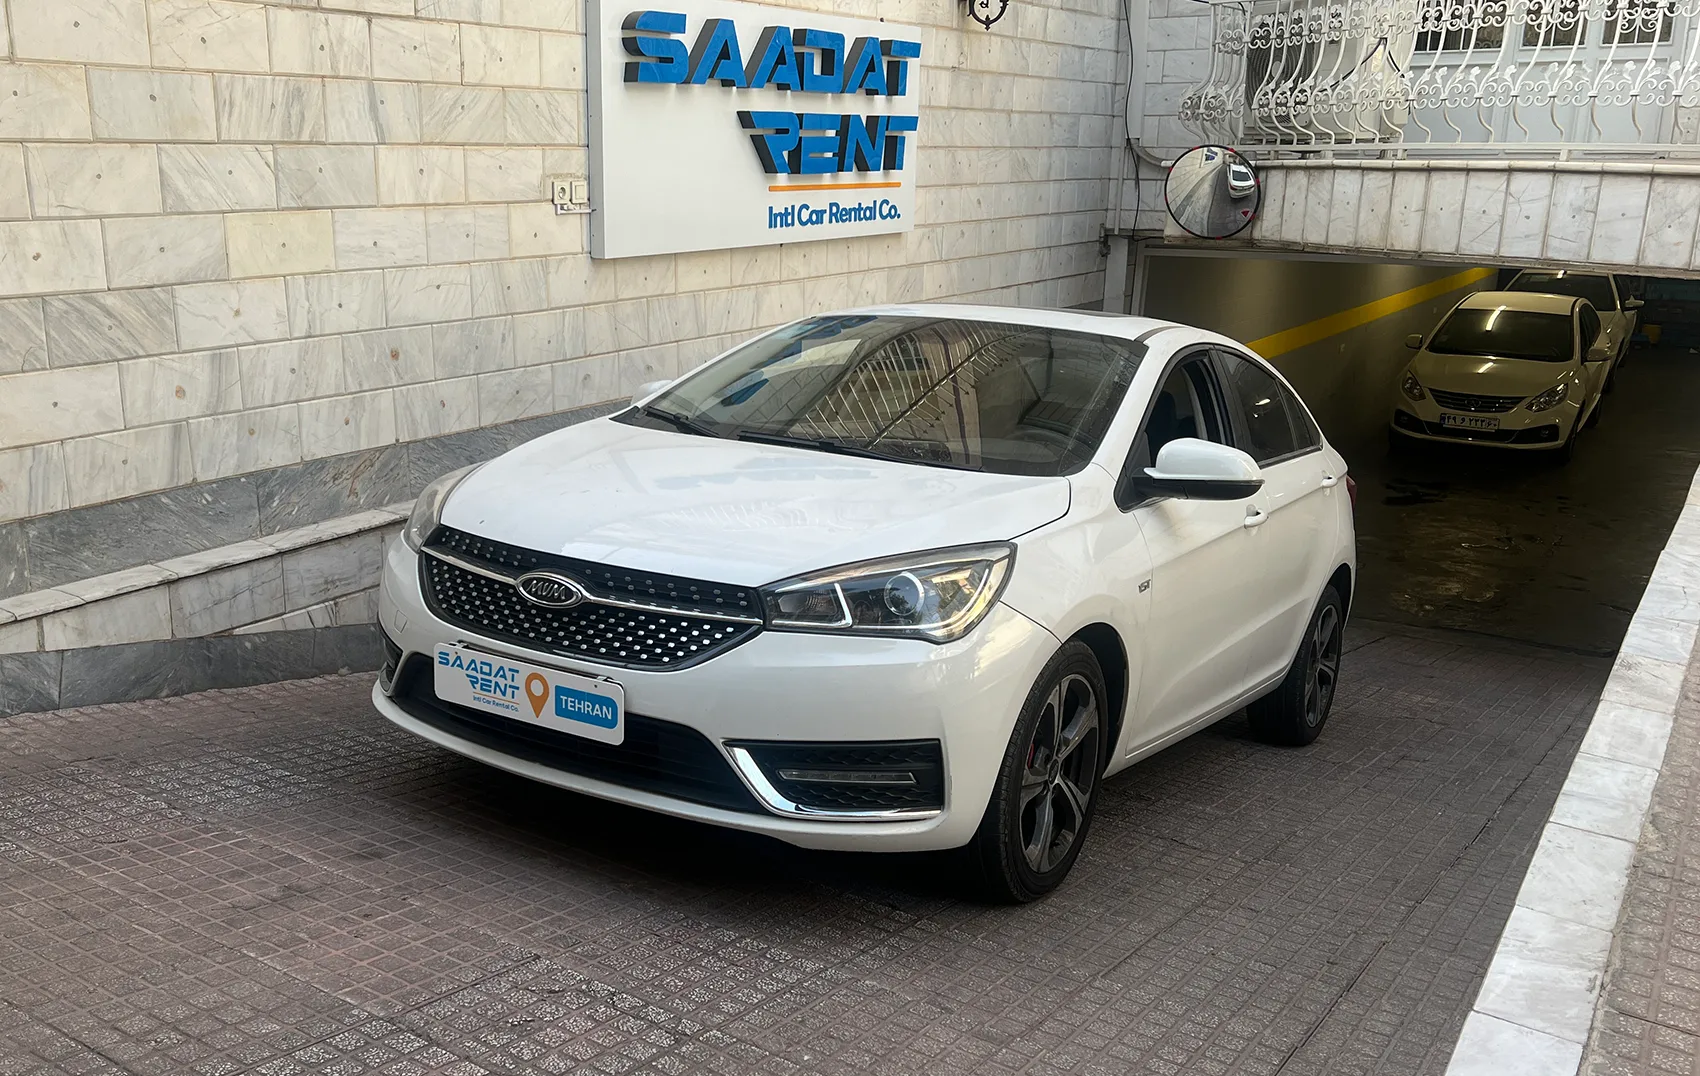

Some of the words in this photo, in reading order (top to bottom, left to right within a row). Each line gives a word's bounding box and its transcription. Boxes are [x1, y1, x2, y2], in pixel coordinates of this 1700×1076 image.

[621, 10, 922, 96] SAADAT
[736, 110, 919, 174] RENT
[768, 204, 795, 229] Intl
[797, 203, 827, 226] Car
[828, 200, 877, 224] Rental
[879, 198, 900, 220] Co.
[438, 651, 520, 683] SAADAT
[465, 673, 520, 700] RENT
[560, 695, 612, 720] TEHRAN
